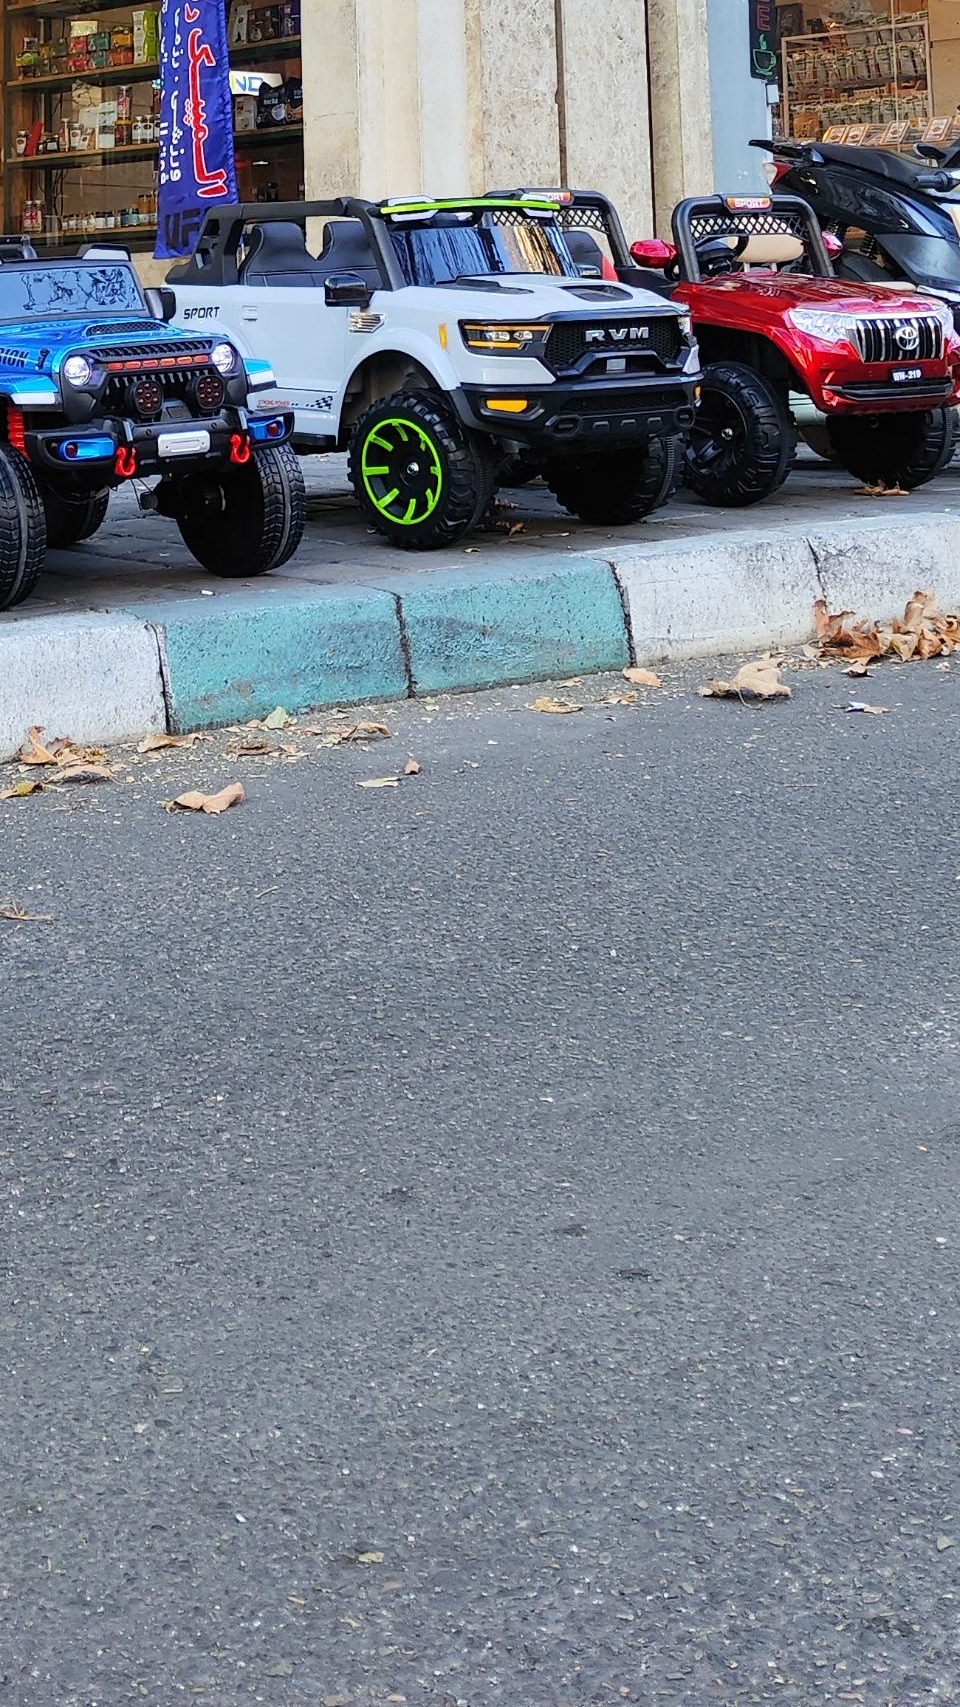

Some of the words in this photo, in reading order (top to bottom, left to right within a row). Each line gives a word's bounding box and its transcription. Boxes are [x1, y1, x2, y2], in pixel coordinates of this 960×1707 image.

[169, 89, 185, 182] ورزشی
[183, 27, 228, 198] المپیک
[183, 306, 220, 320] SPORT
[585, 326, 649, 342] RVM
